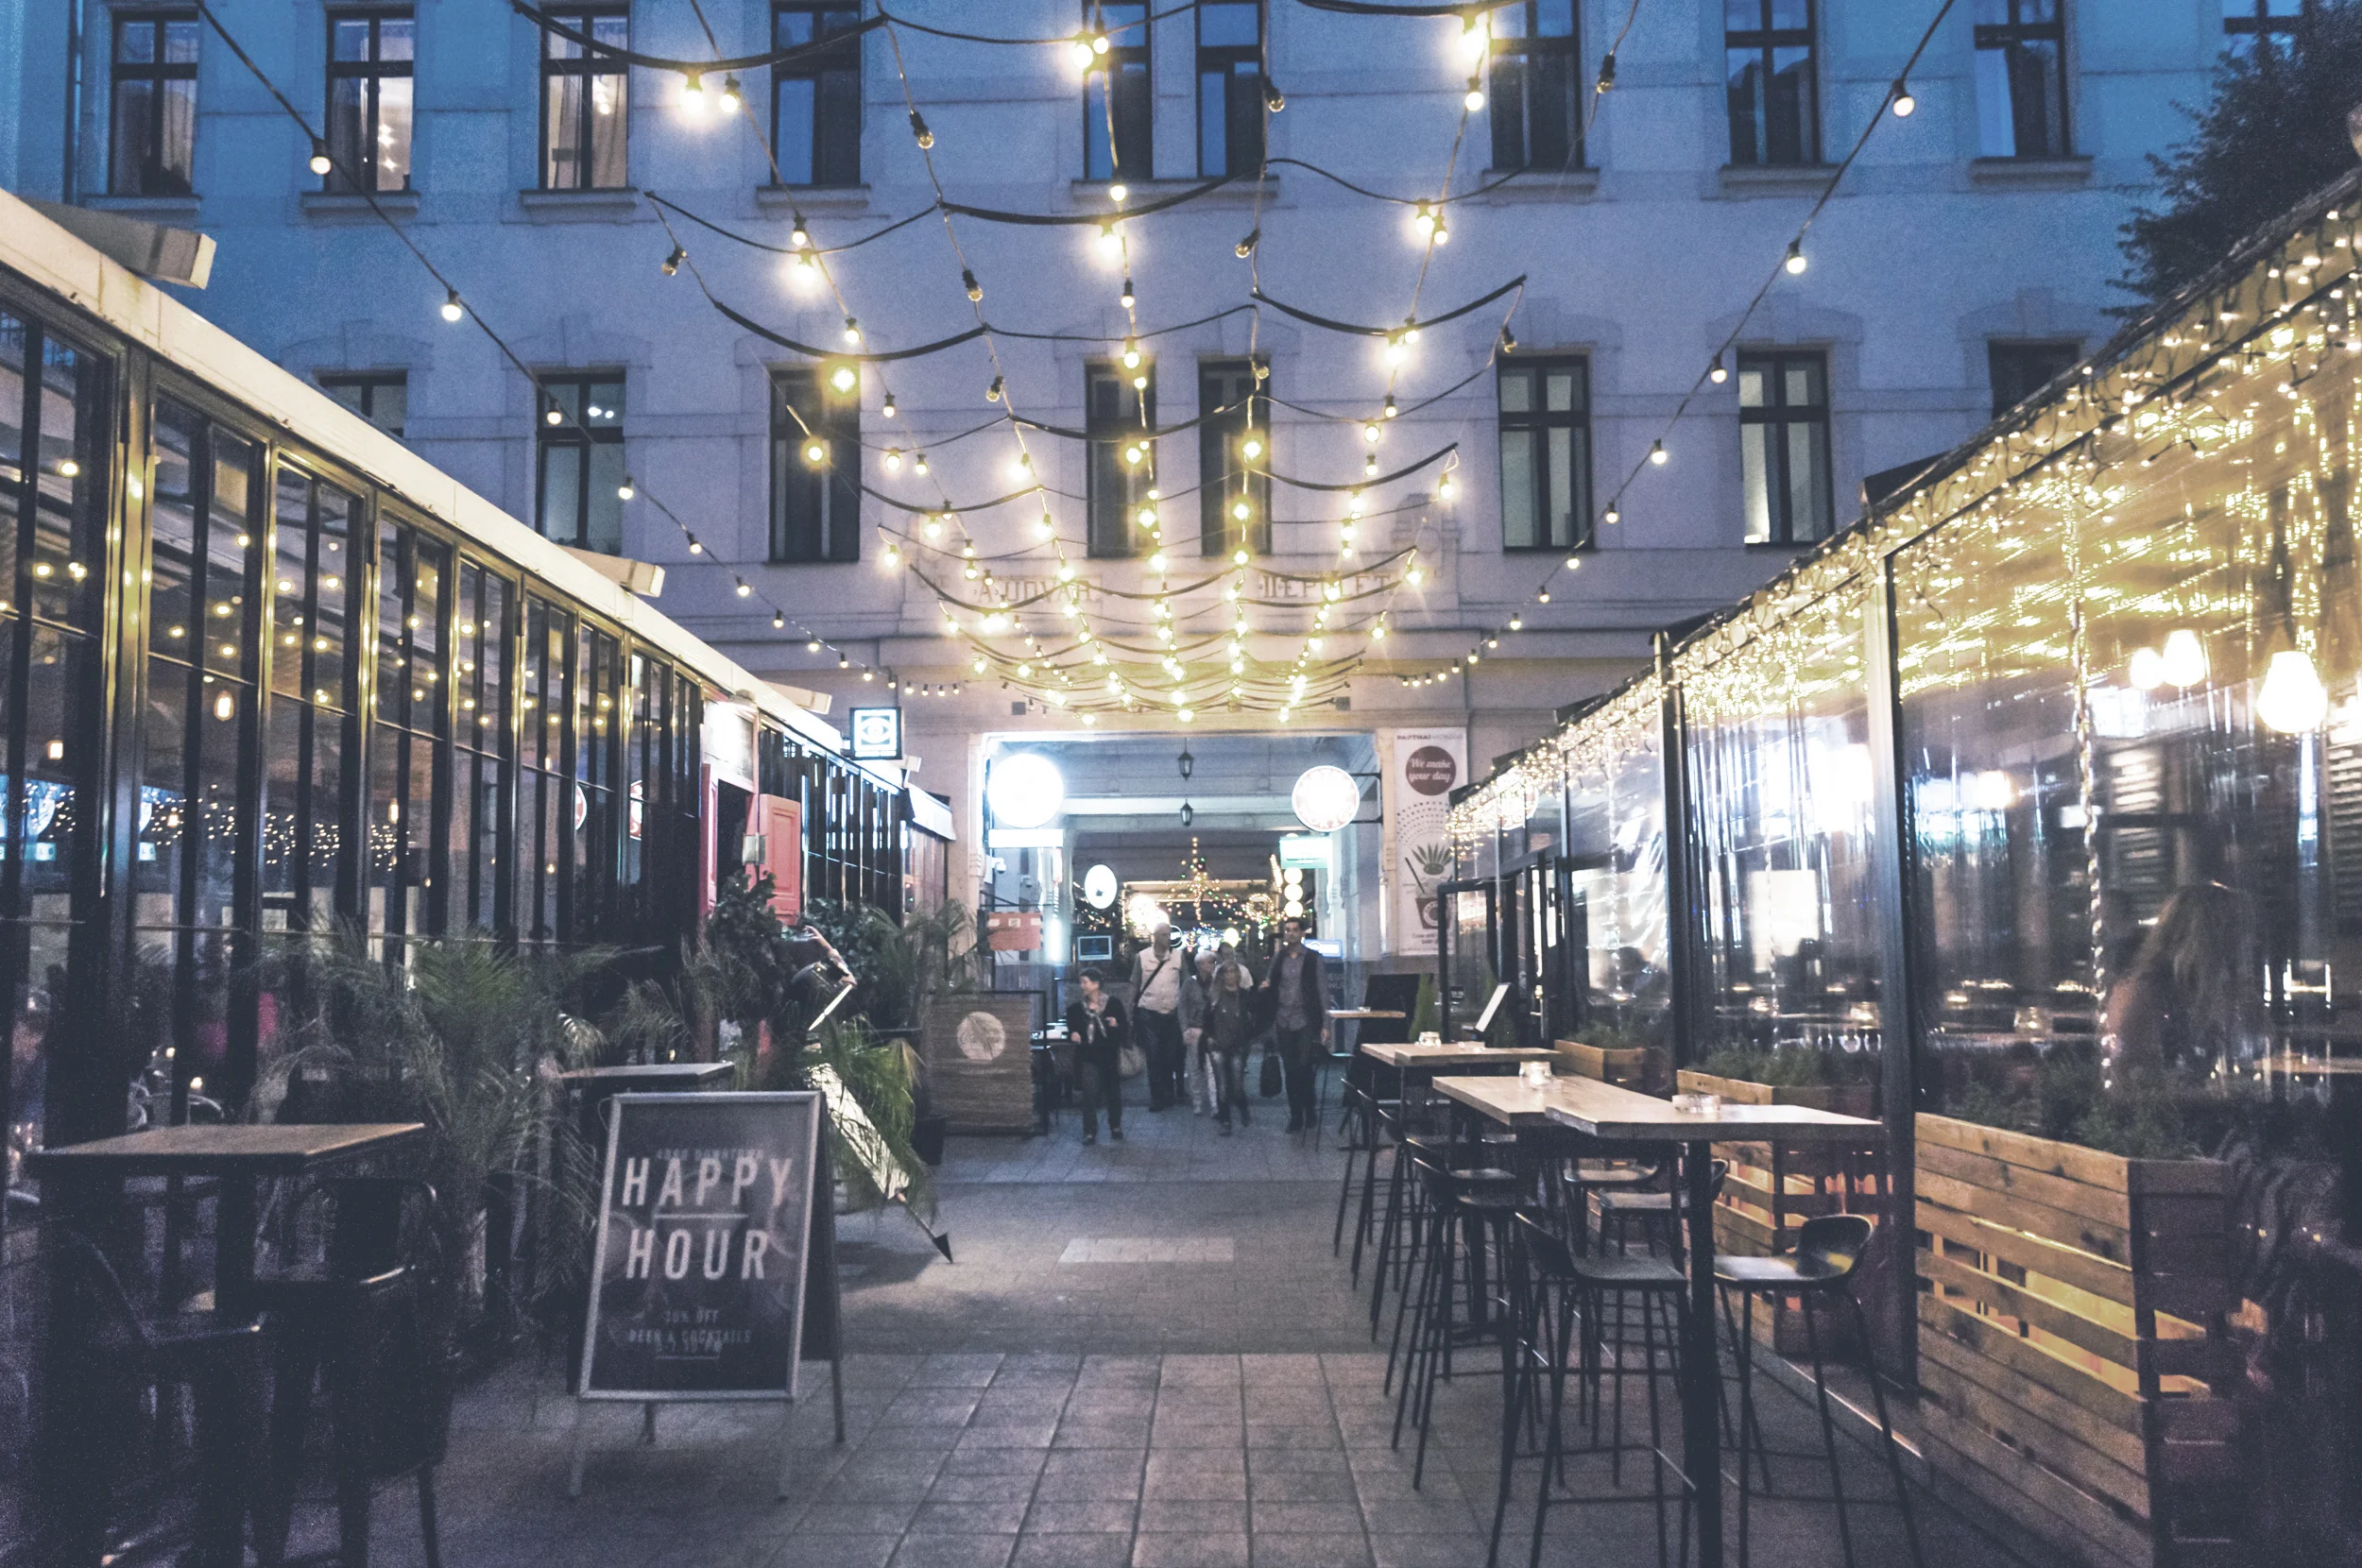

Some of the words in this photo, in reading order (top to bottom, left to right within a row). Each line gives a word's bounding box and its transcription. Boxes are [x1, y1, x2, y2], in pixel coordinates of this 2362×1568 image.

[1410, 758, 1425, 768] We
[1426, 759, 1452, 768] make
[1409, 773, 1431, 783] your
[622, 1157, 793, 1206] HAPPY
[625, 1229, 769, 1279] HOUR
